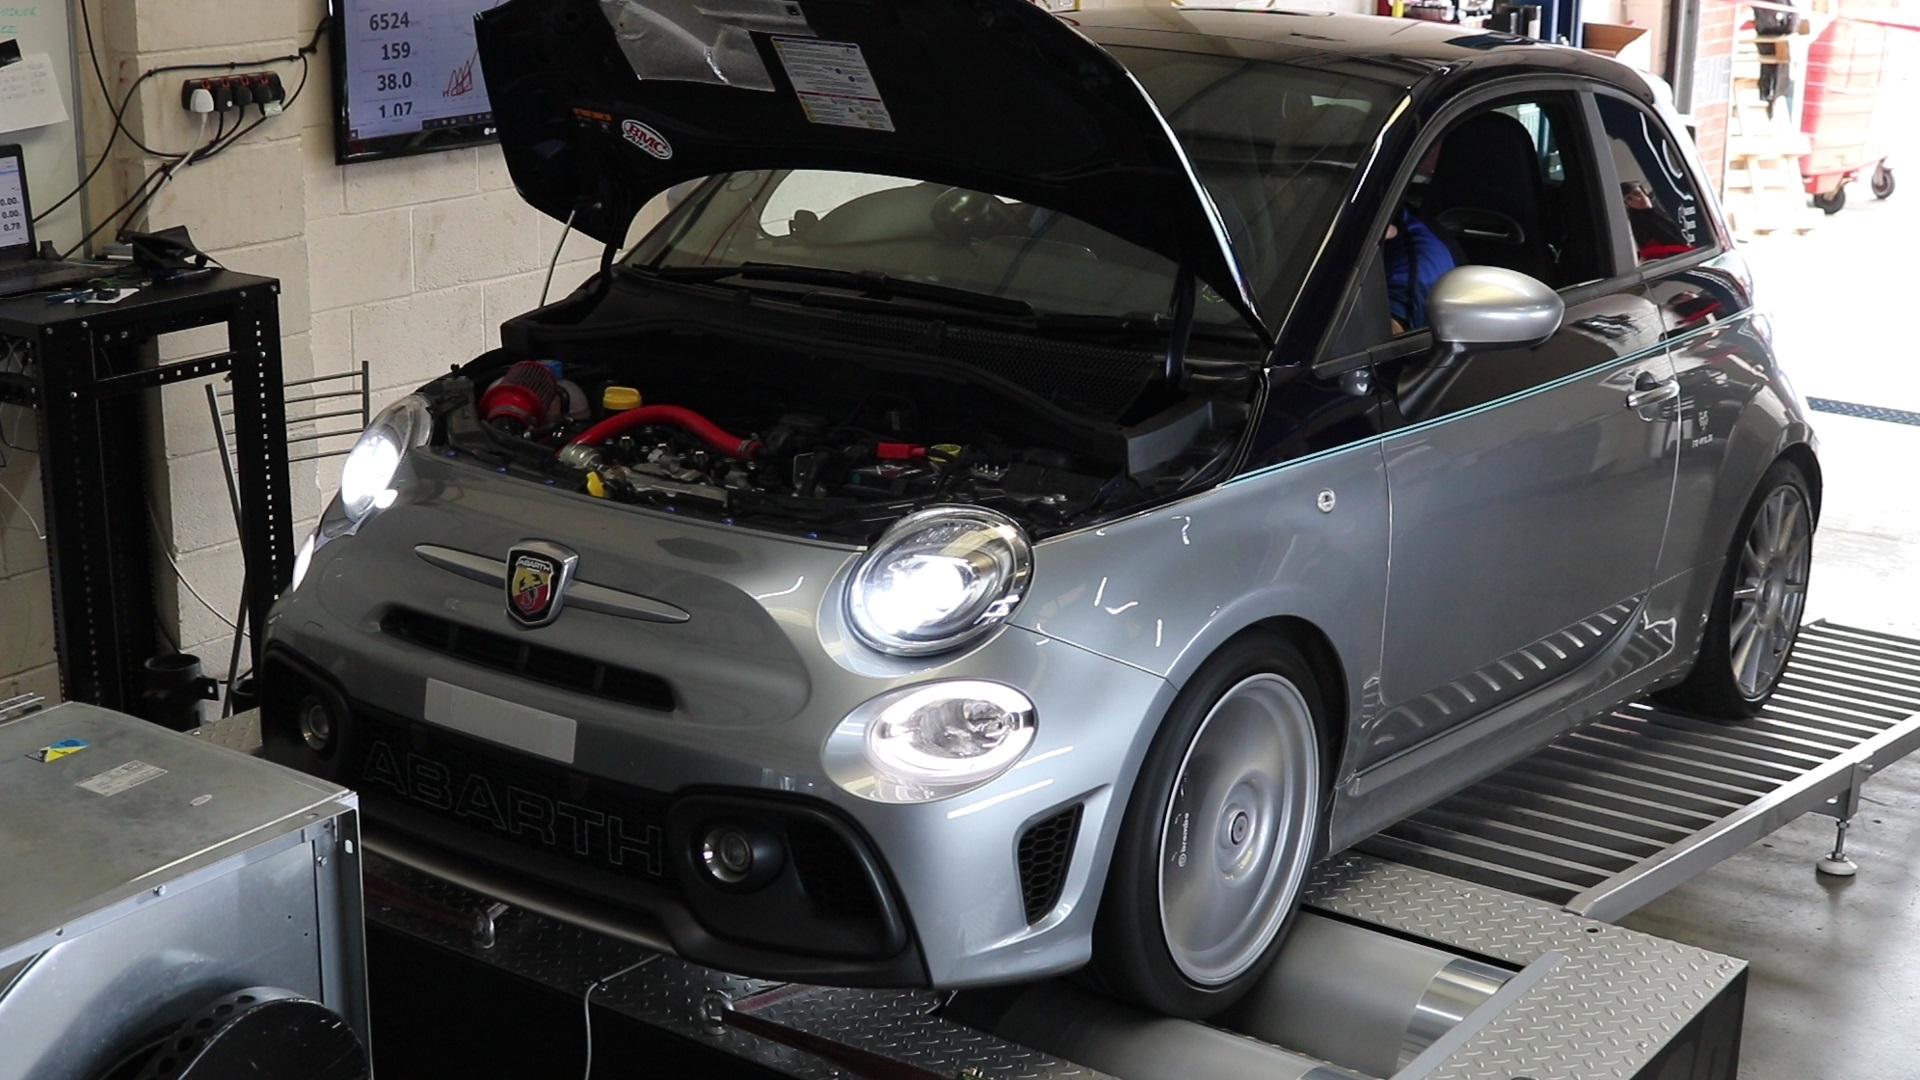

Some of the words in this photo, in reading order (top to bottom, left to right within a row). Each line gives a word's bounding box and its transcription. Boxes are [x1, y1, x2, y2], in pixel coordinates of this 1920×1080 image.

[369, 12, 410, 31] 6524
[381, 42, 411, 60] 159
[377, 72, 412, 91] 38.0
[628, 122, 668, 154] BMC
[520, 559, 550, 571] ABARTH
[362, 740, 662, 876] ABARTH
